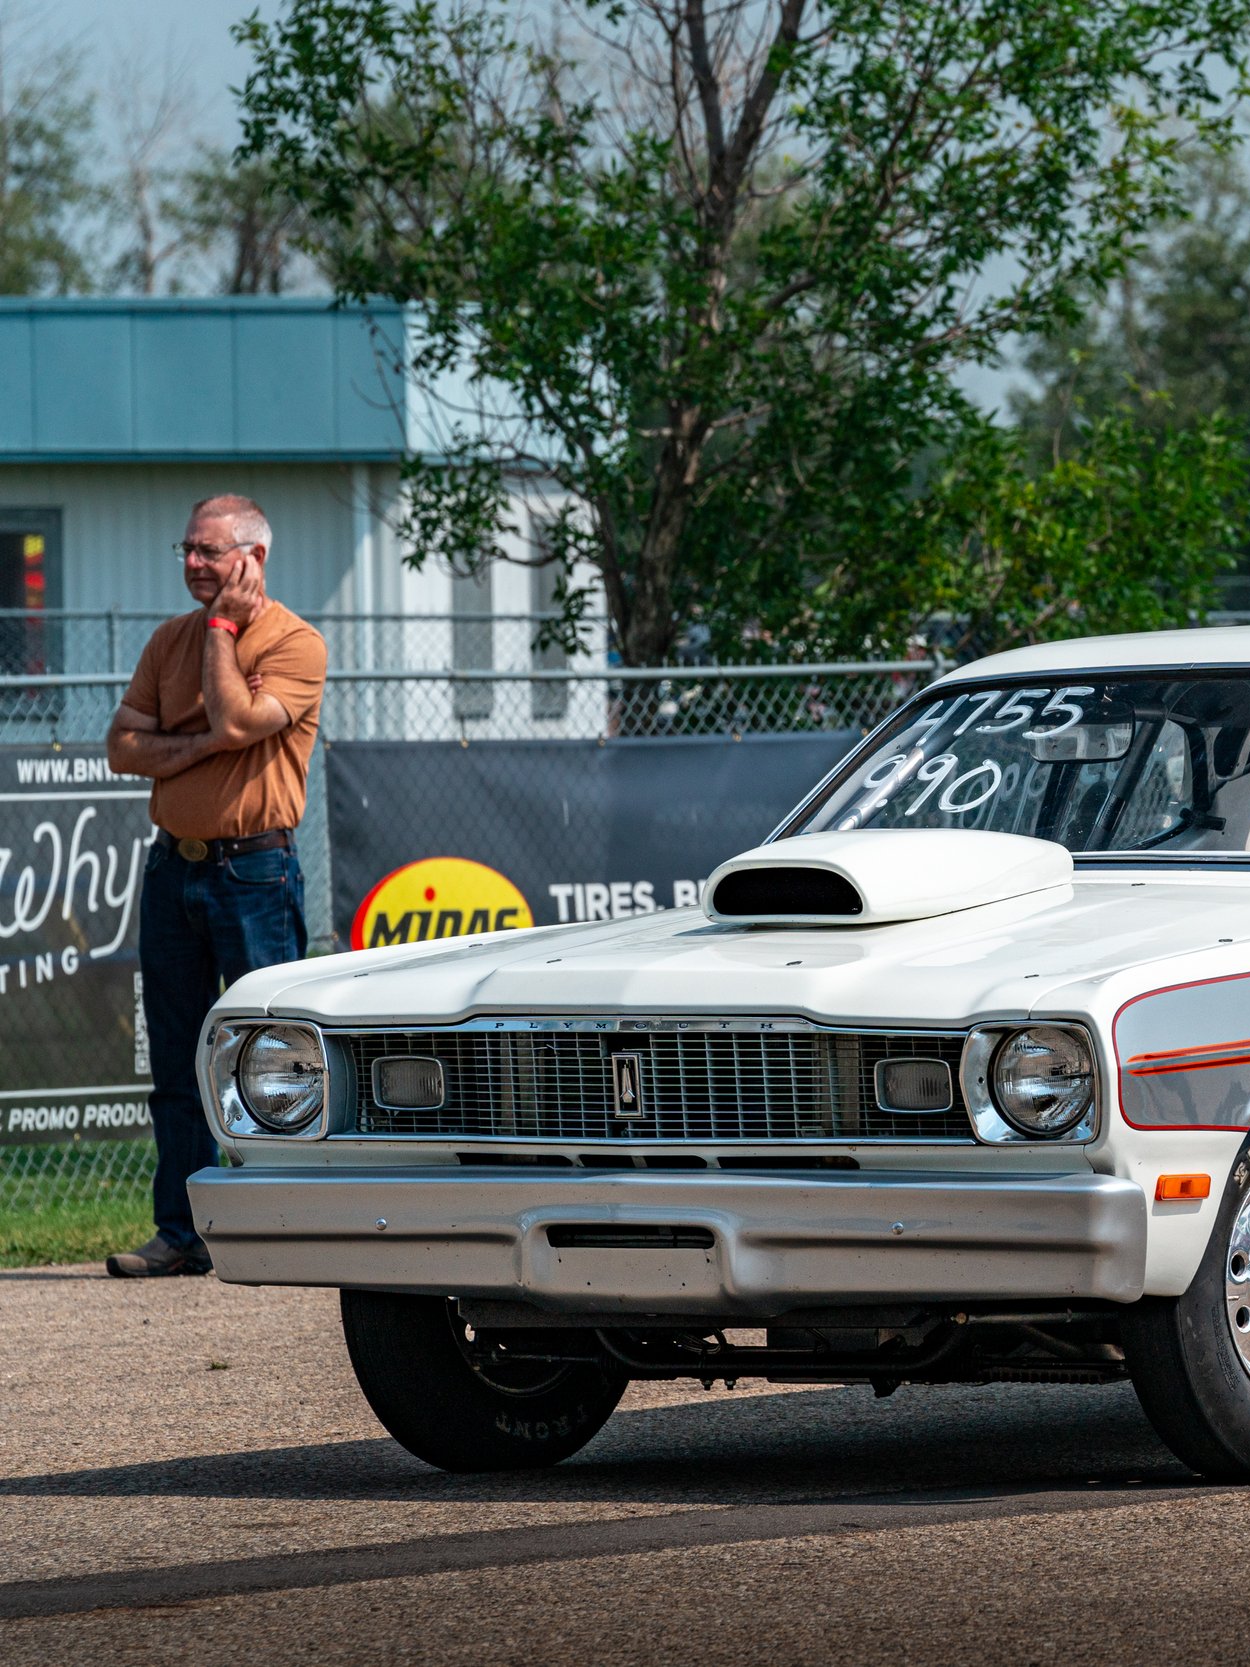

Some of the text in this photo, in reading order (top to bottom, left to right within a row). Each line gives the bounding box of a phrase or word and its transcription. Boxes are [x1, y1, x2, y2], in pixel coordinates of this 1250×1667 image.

[914, 686, 1095, 747] 4755
[494, 1021, 777, 1031] PLYMOUTH
[8, 1104, 80, 1132] PROMO
[83, 1101, 154, 1129] PRODU
